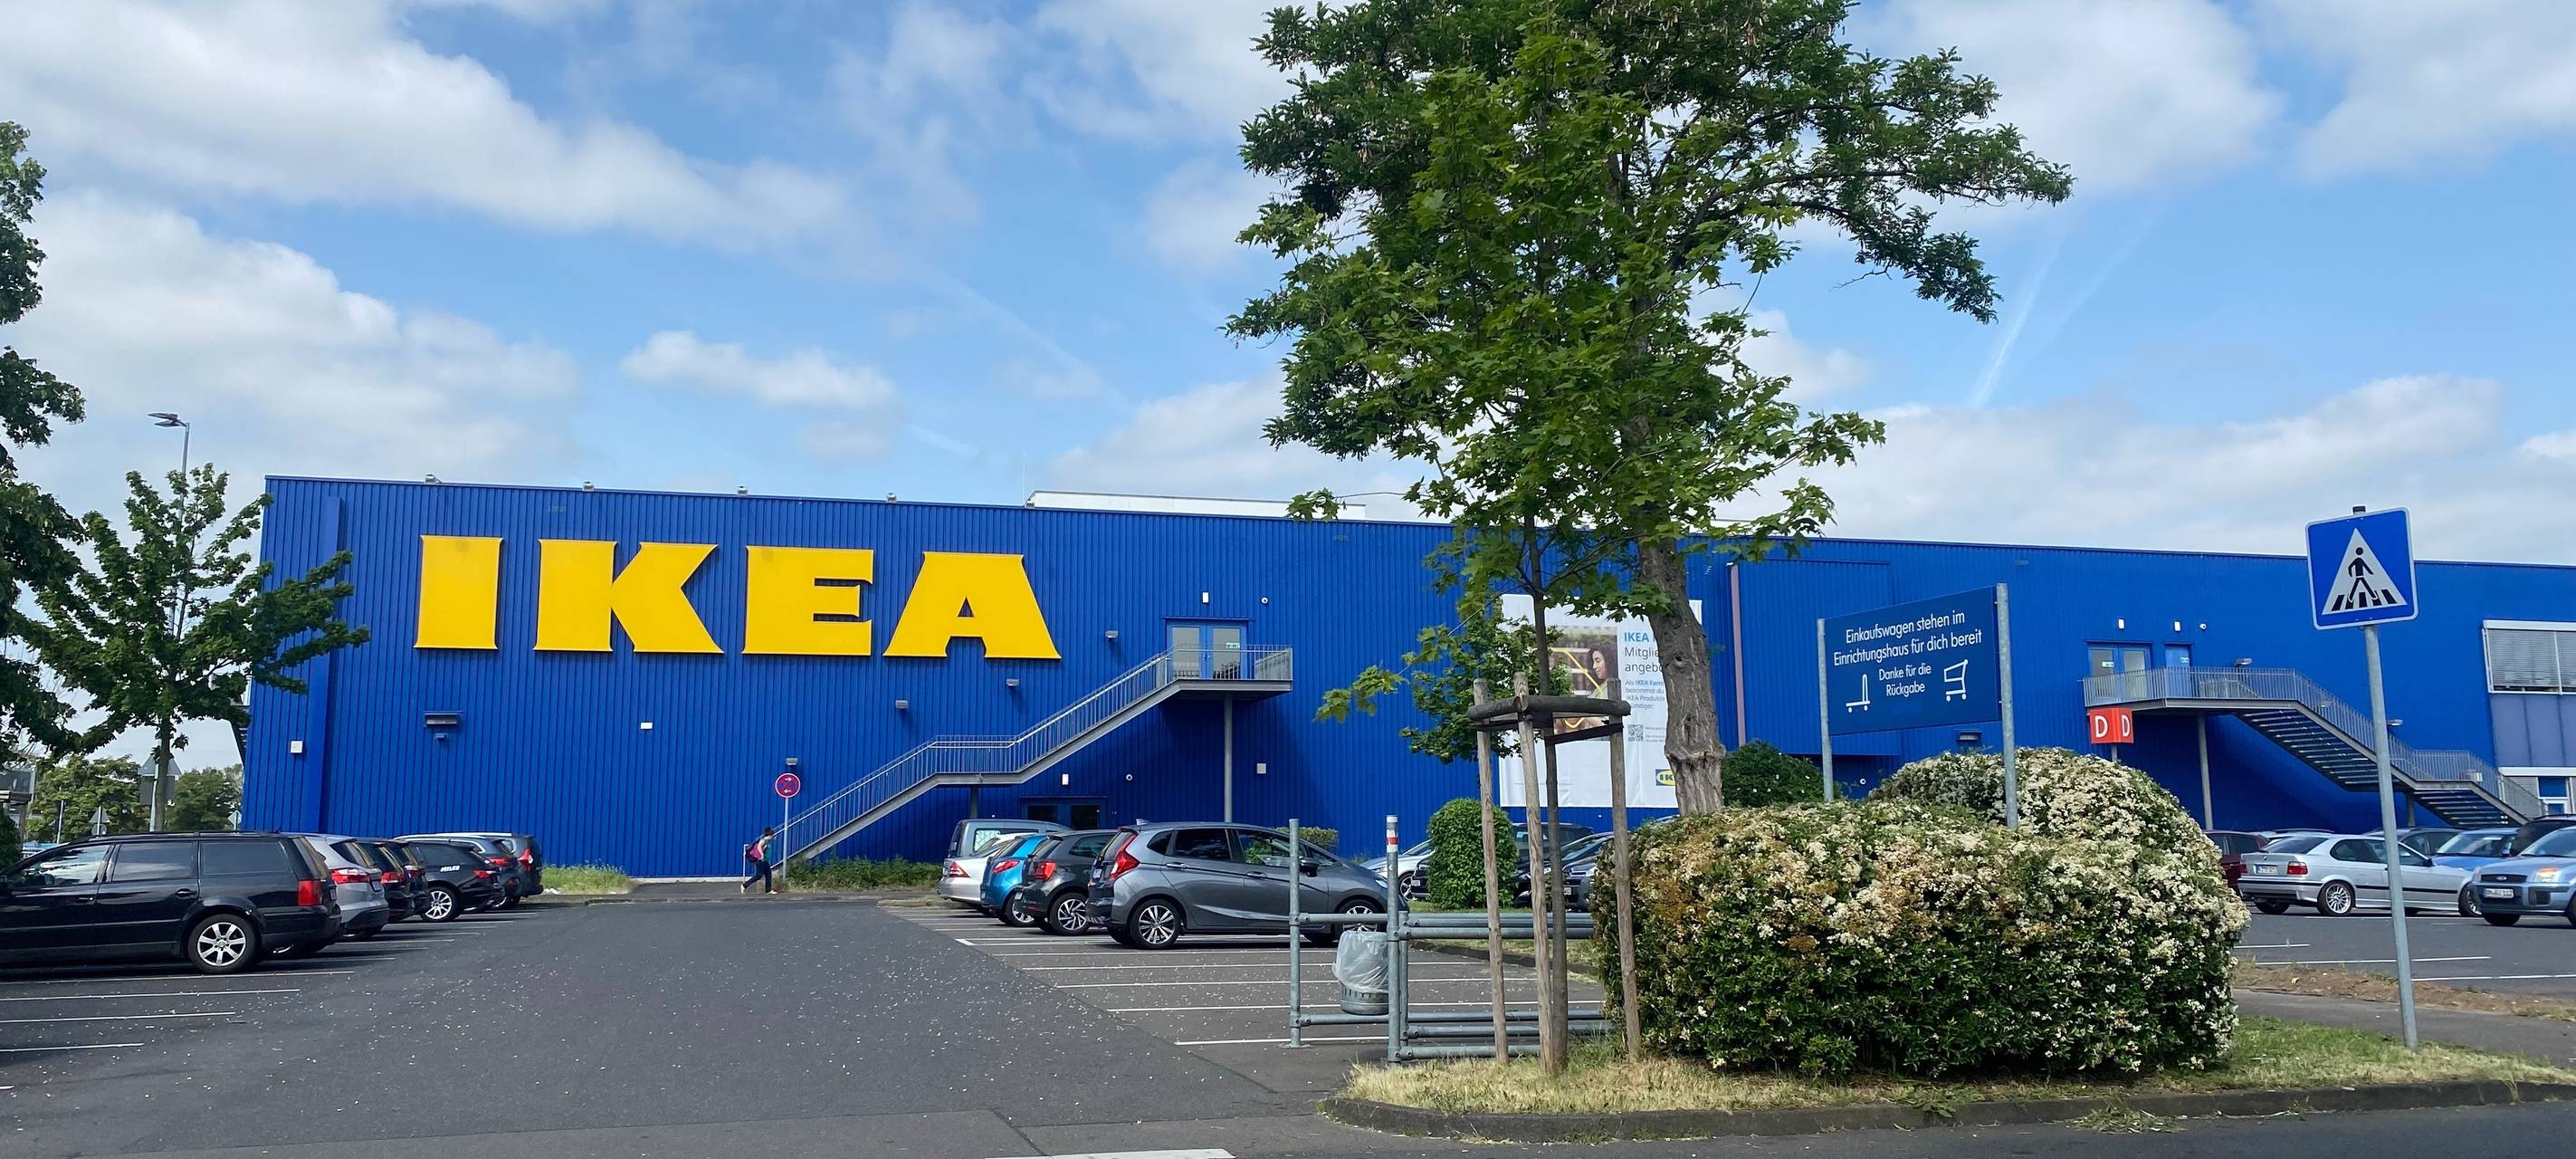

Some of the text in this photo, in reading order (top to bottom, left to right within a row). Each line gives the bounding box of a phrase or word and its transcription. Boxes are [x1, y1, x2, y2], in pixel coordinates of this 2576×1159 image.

[414, 534, 1062, 658] IKEA
[1624, 632, 1649, 642] IKEA
[1846, 609, 1965, 644] Einkaufswagen stehen im
[1834, 628, 1982, 666] Einrichtungshaus für dich bereit
[1878, 662, 1932, 681] Danke für die
[1886, 680, 1925, 697] Rückgabe
[2094, 714, 2108, 738] D
[2121, 714, 2131, 737] D
